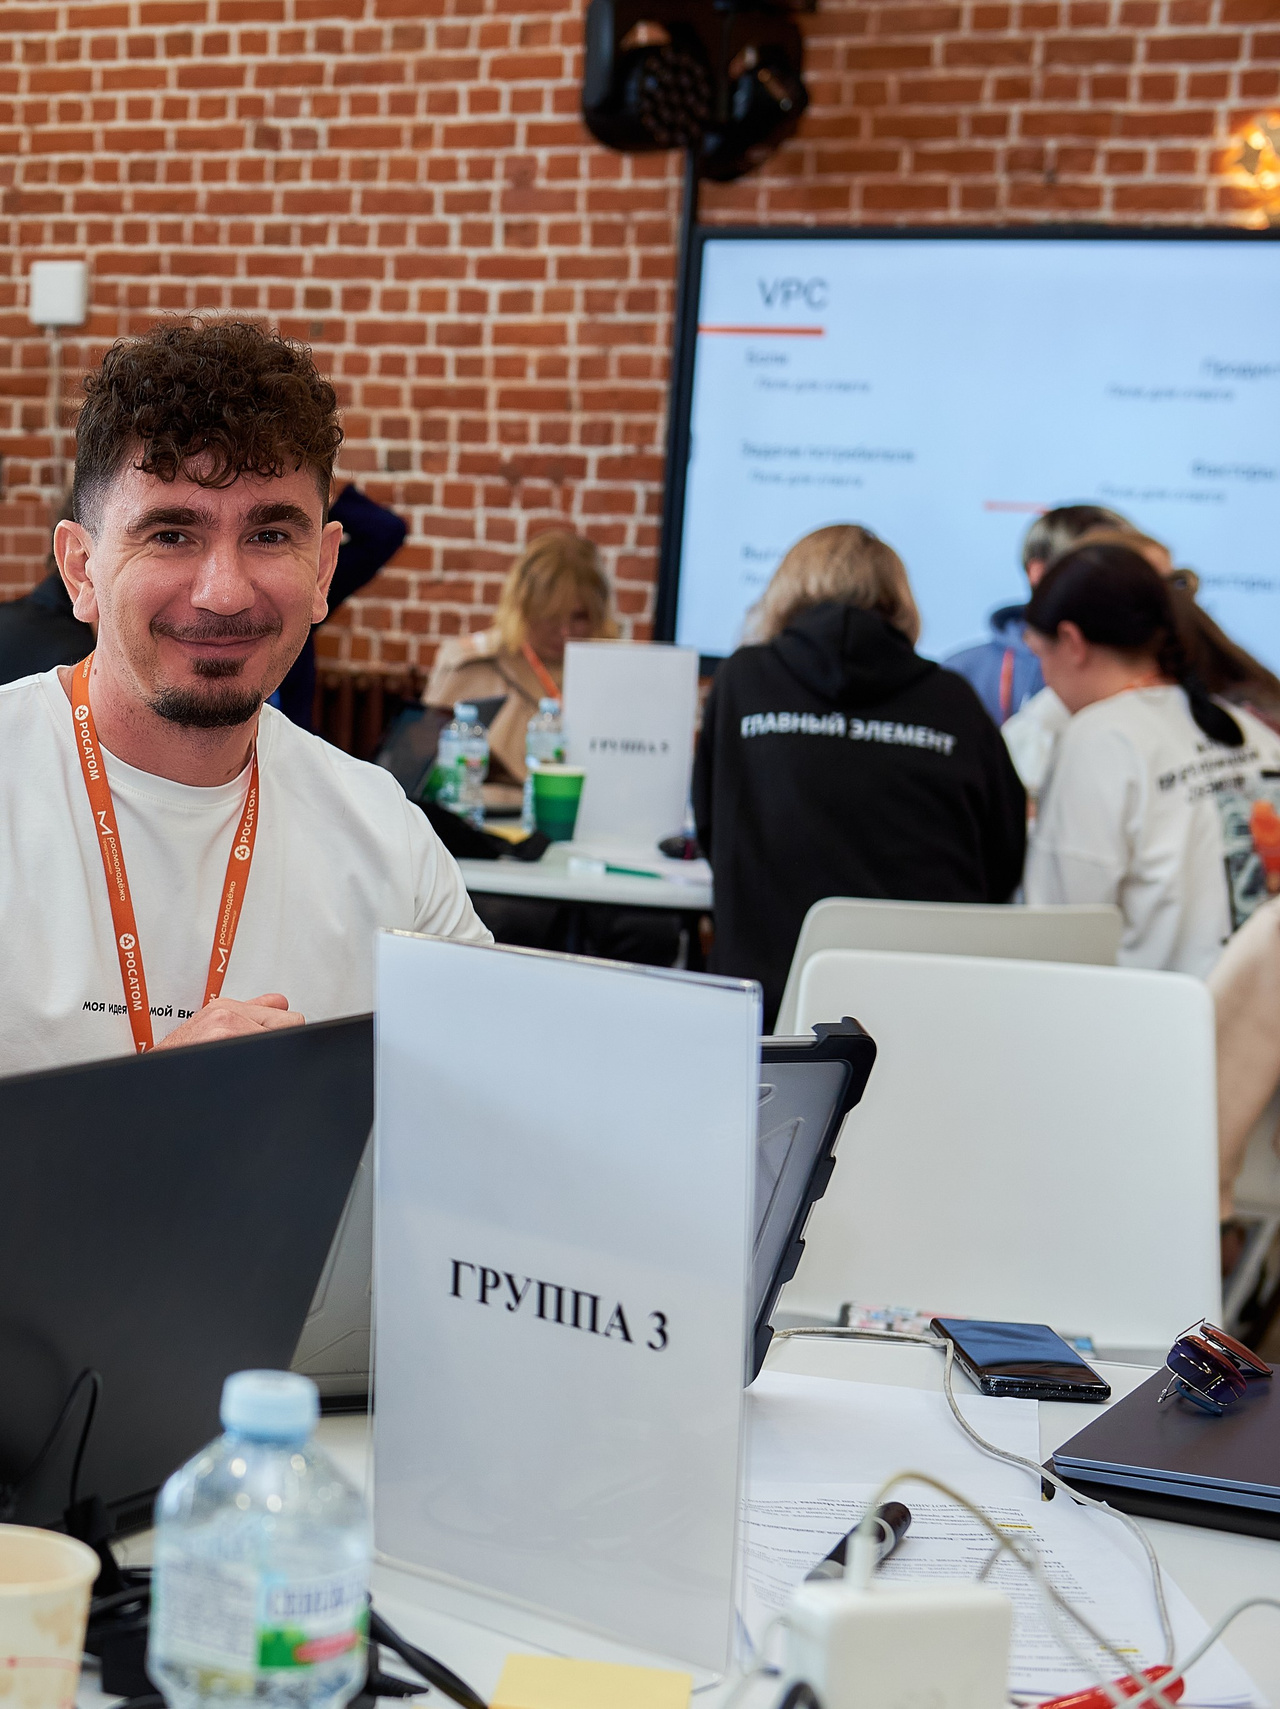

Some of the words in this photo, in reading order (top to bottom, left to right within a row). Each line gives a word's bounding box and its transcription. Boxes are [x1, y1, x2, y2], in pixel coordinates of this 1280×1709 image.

[757, 276, 829, 311] VPC
[79, 721, 100, 781] РОСАТОМ
[740, 711, 846, 739] ГЛАВНЫЙ
[848, 717, 957, 756] ЭЛЕМЕНТ
[240, 788, 257, 843] РОСАТОМ
[124, 951, 143, 1011] РОСАТОМ
[82, 1001, 106, 1012] моя
[108, 1003, 128, 1015] идея
[149, 1005, 173, 1017] мой
[448, 1258, 634, 1344] ГРУППА
[647, 1311, 668, 1351] 3
